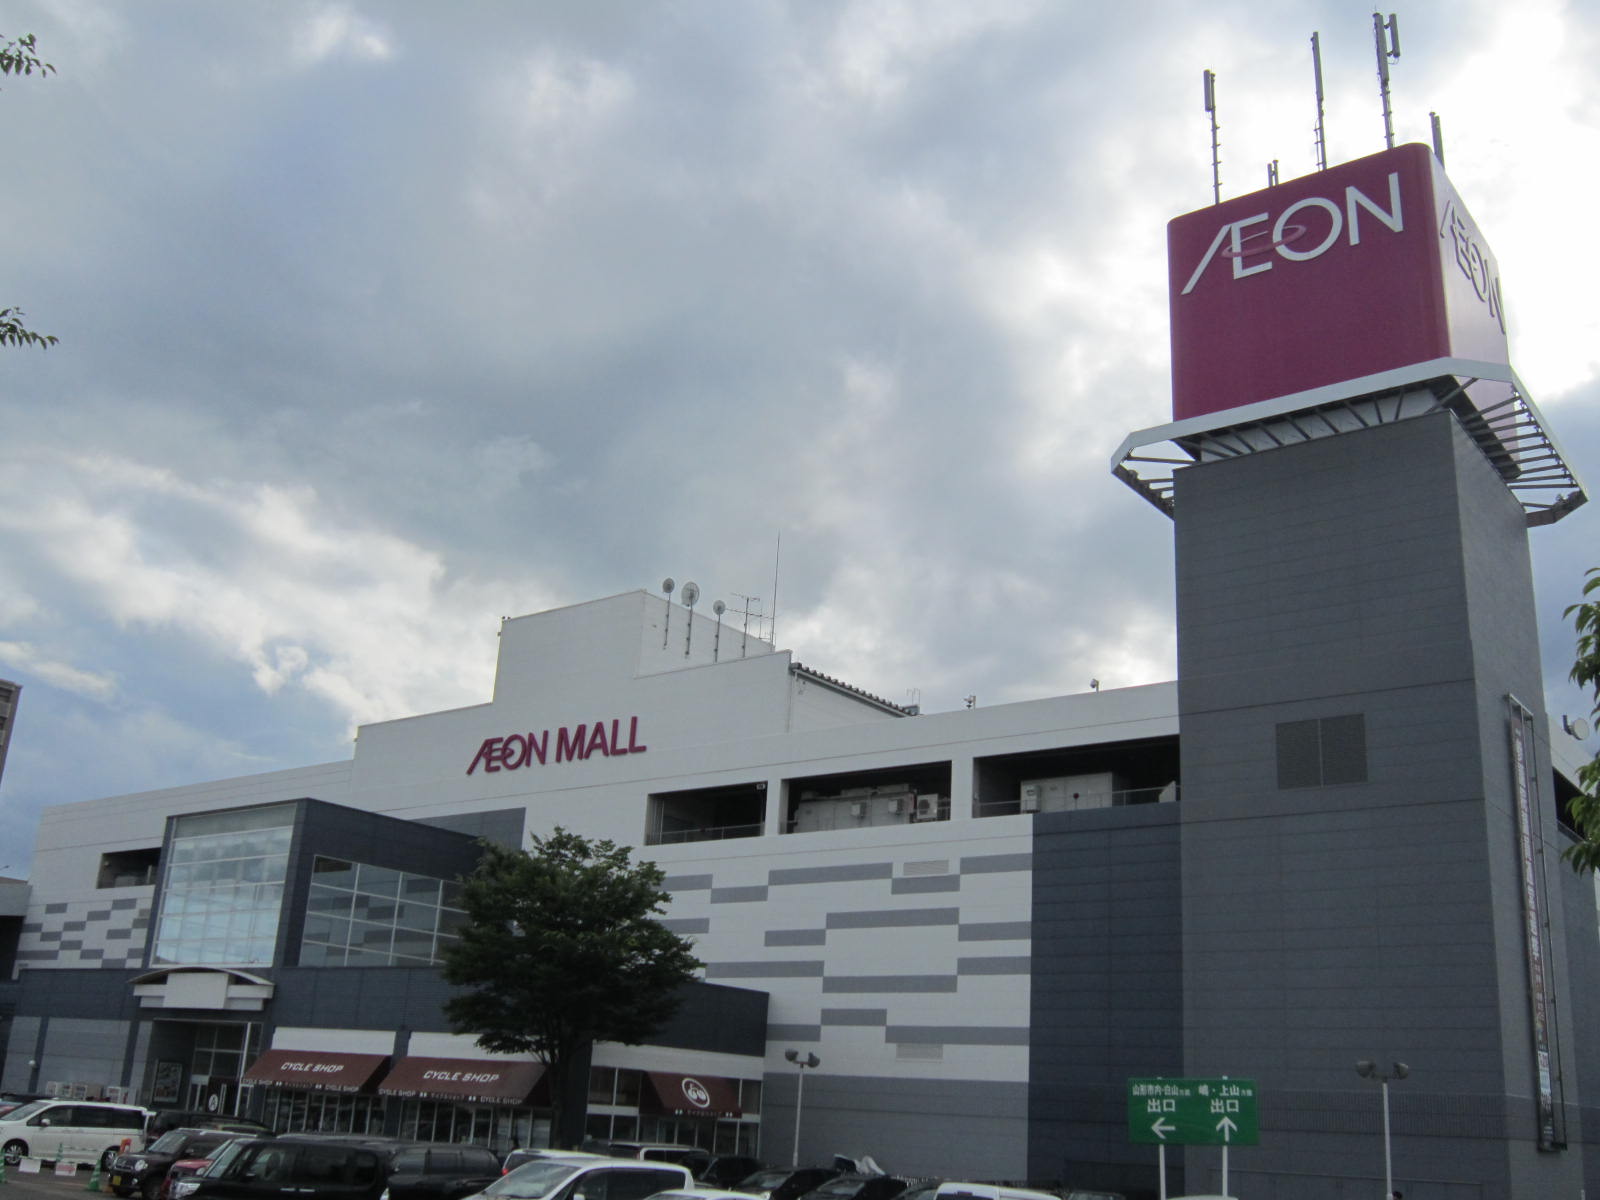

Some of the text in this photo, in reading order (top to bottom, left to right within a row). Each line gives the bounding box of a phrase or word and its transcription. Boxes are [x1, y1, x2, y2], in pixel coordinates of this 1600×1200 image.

[555, 716, 647, 763] MALL
[280, 1062, 344, 1074] CYCLE SHOP
[423, 1070, 500, 1083] CYCLE SHOP
[398, 1089, 416, 1097] SHOP
[1147, 1098, 1176, 1113] 出口
[1210, 1098, 1239, 1113] 出口
